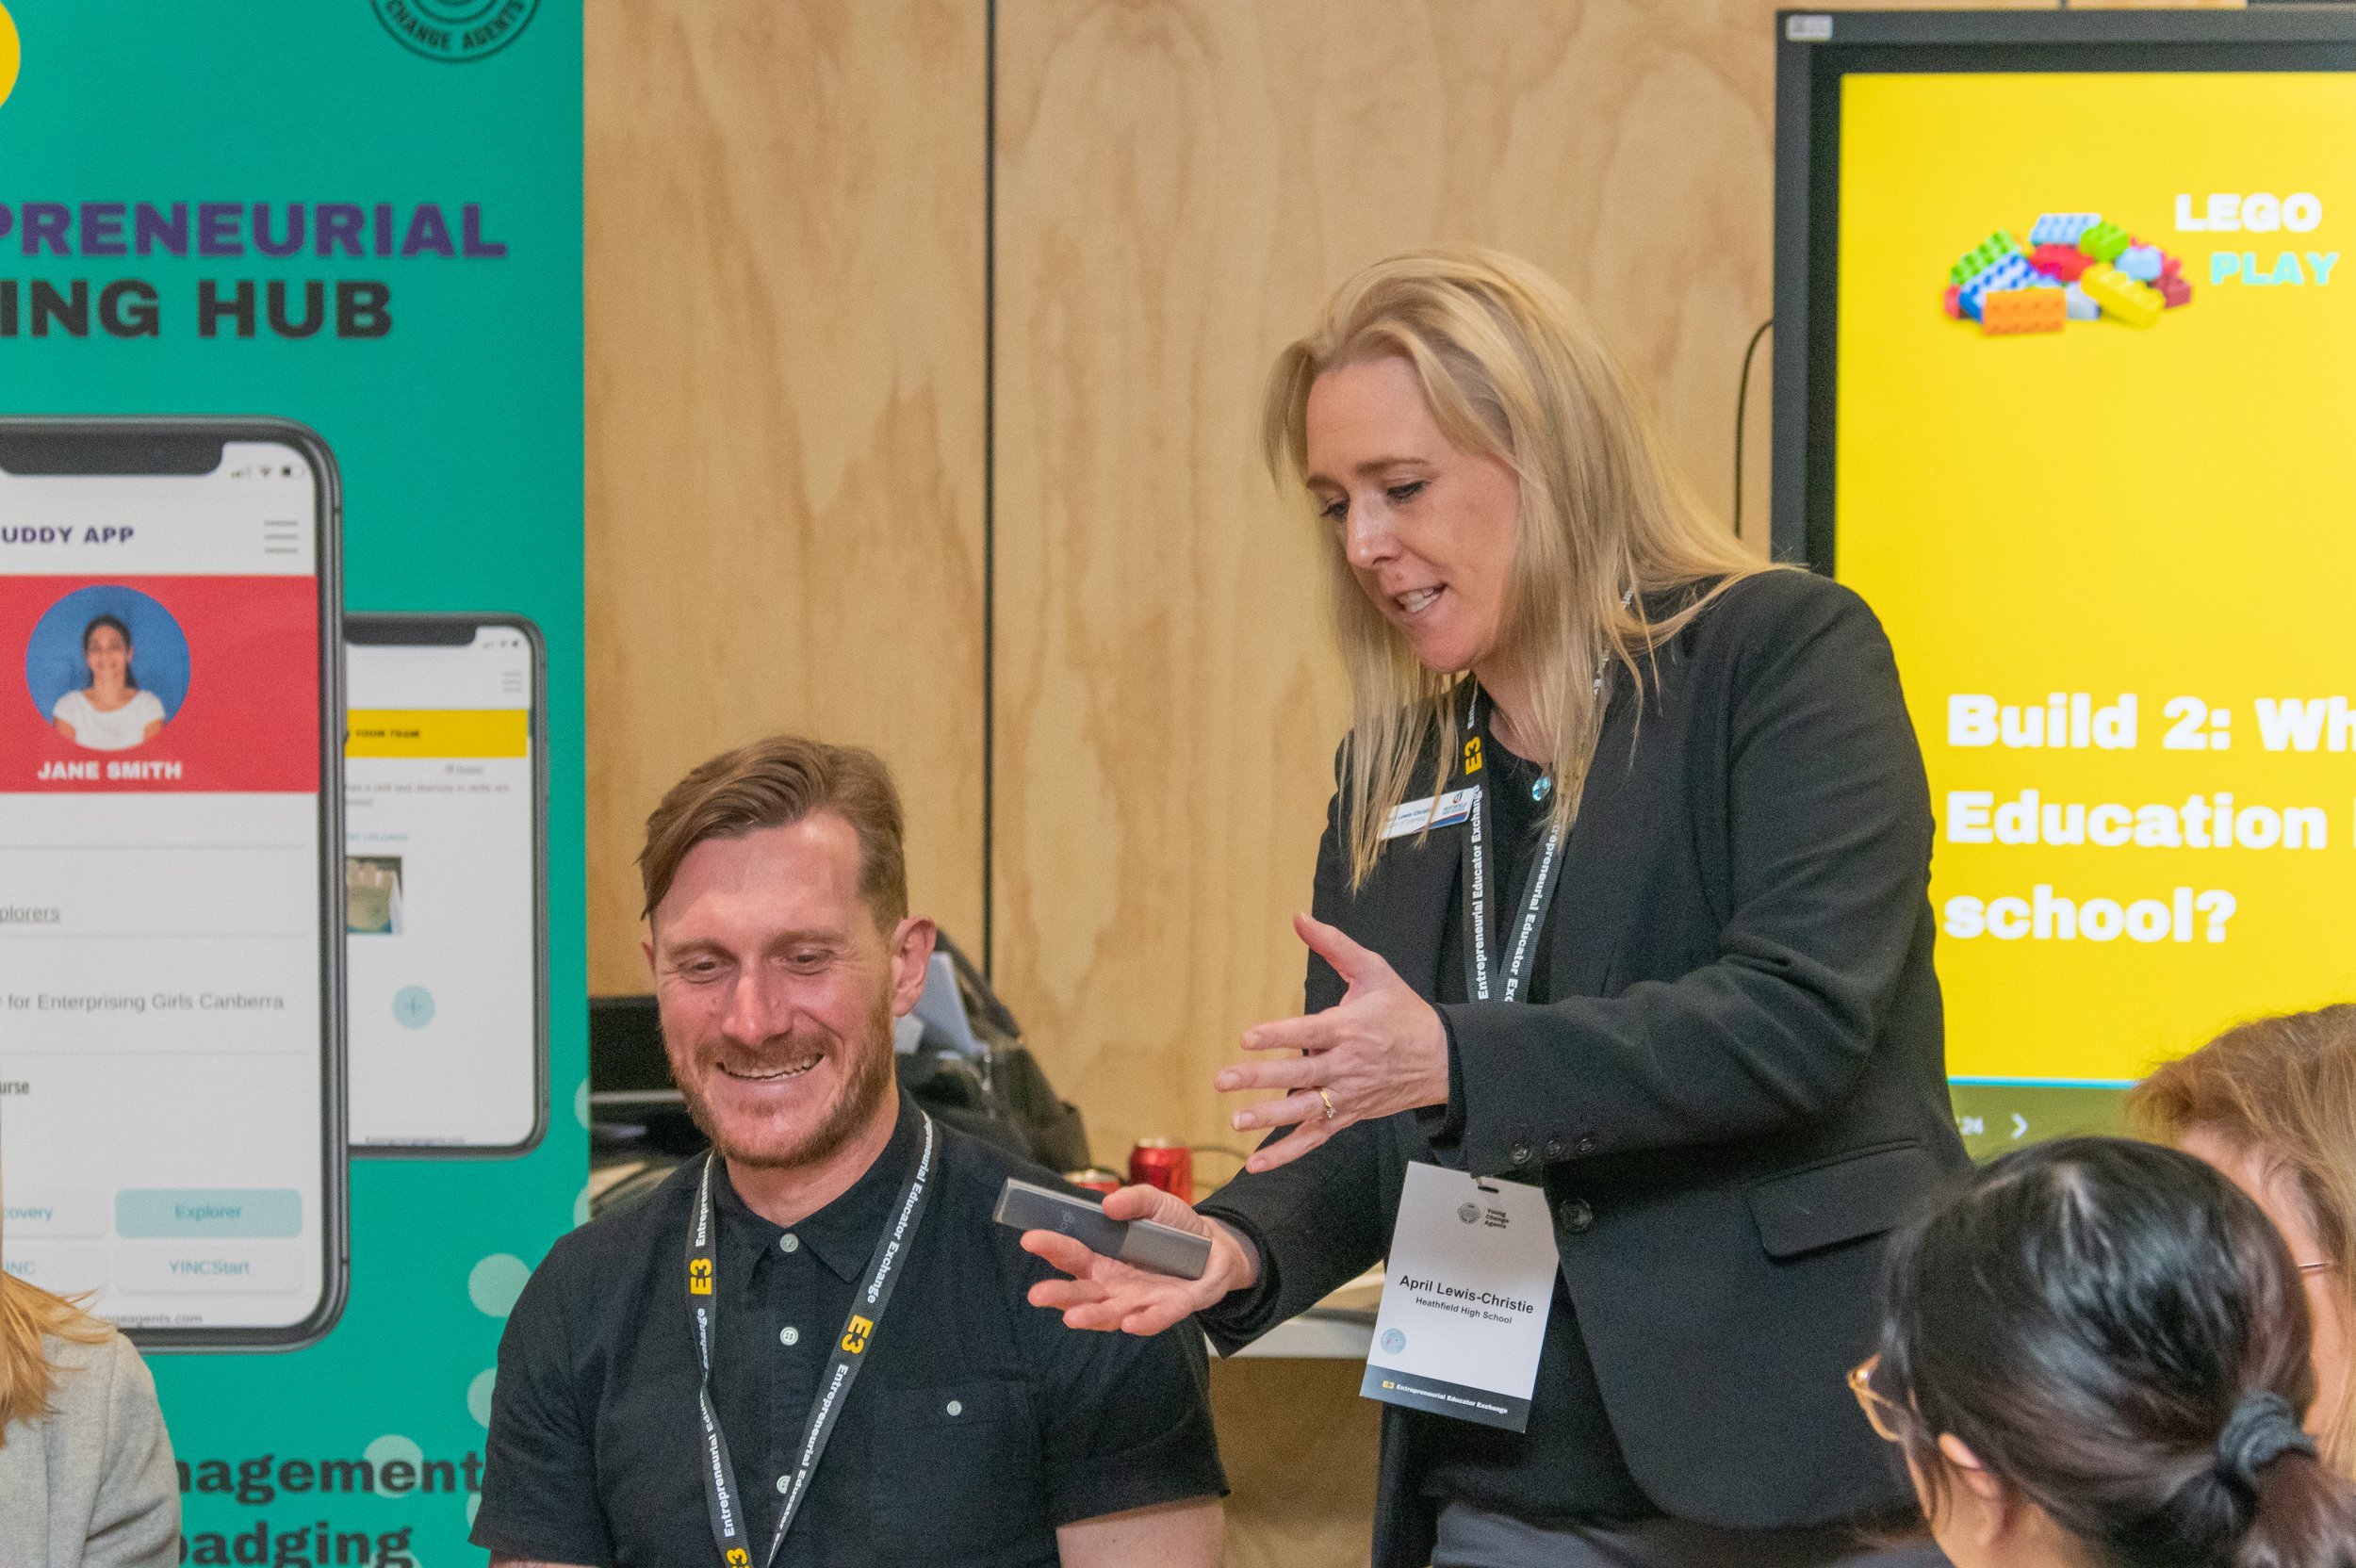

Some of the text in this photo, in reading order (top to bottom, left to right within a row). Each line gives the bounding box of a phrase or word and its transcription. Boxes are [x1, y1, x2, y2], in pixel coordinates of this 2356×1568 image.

[0, 202, 507, 258] RENEURIAL
[2175, 192, 2322, 234] LEGO
[2210, 252, 2340, 286] PLAY
[197, 279, 392, 339] HUB
[1, 526, 135, 544] UDDY APP
[1947, 693, 2137, 751] Build
[2162, 695, 2232, 751] 2:
[38, 760, 182, 780] JANE SMITH
[1464, 736, 1482, 776] E3
[1946, 789, 2328, 850] Education
[1529, 825, 1560, 911] repreneurial
[1470, 784, 1489, 1001] Entrepreneurial Educator Exchange
[1943, 884, 2237, 943] school?
[1511, 913, 1536, 975] Educator
[8, 993, 30, 1010] for
[37, 993, 145, 1014] Enterprising
[152, 993, 193, 1010] Girls
[199, 993, 284, 1010] Canberra
[175, 1203, 242, 1221] Explorer
[894, 1182, 923, 1240] Educator
[170, 1259, 250, 1276] YINCStart
[690, 1258, 712, 1296] E3
[867, 1240, 900, 1304] Exchange
[1399, 1275, 1534, 1315] April Lewis-Christie
[1415, 1297, 1513, 1324] Heathfield High School
[842, 1315, 874, 1354] E3
[801, 1364, 848, 1467] Entrepreneurial
[1383, 1380, 1508, 1413] E3 Entrepreneurial Educator Exchange
[709, 1433, 735, 1538] Entrepreneurial
[180, 1521, 412, 1568] adging
